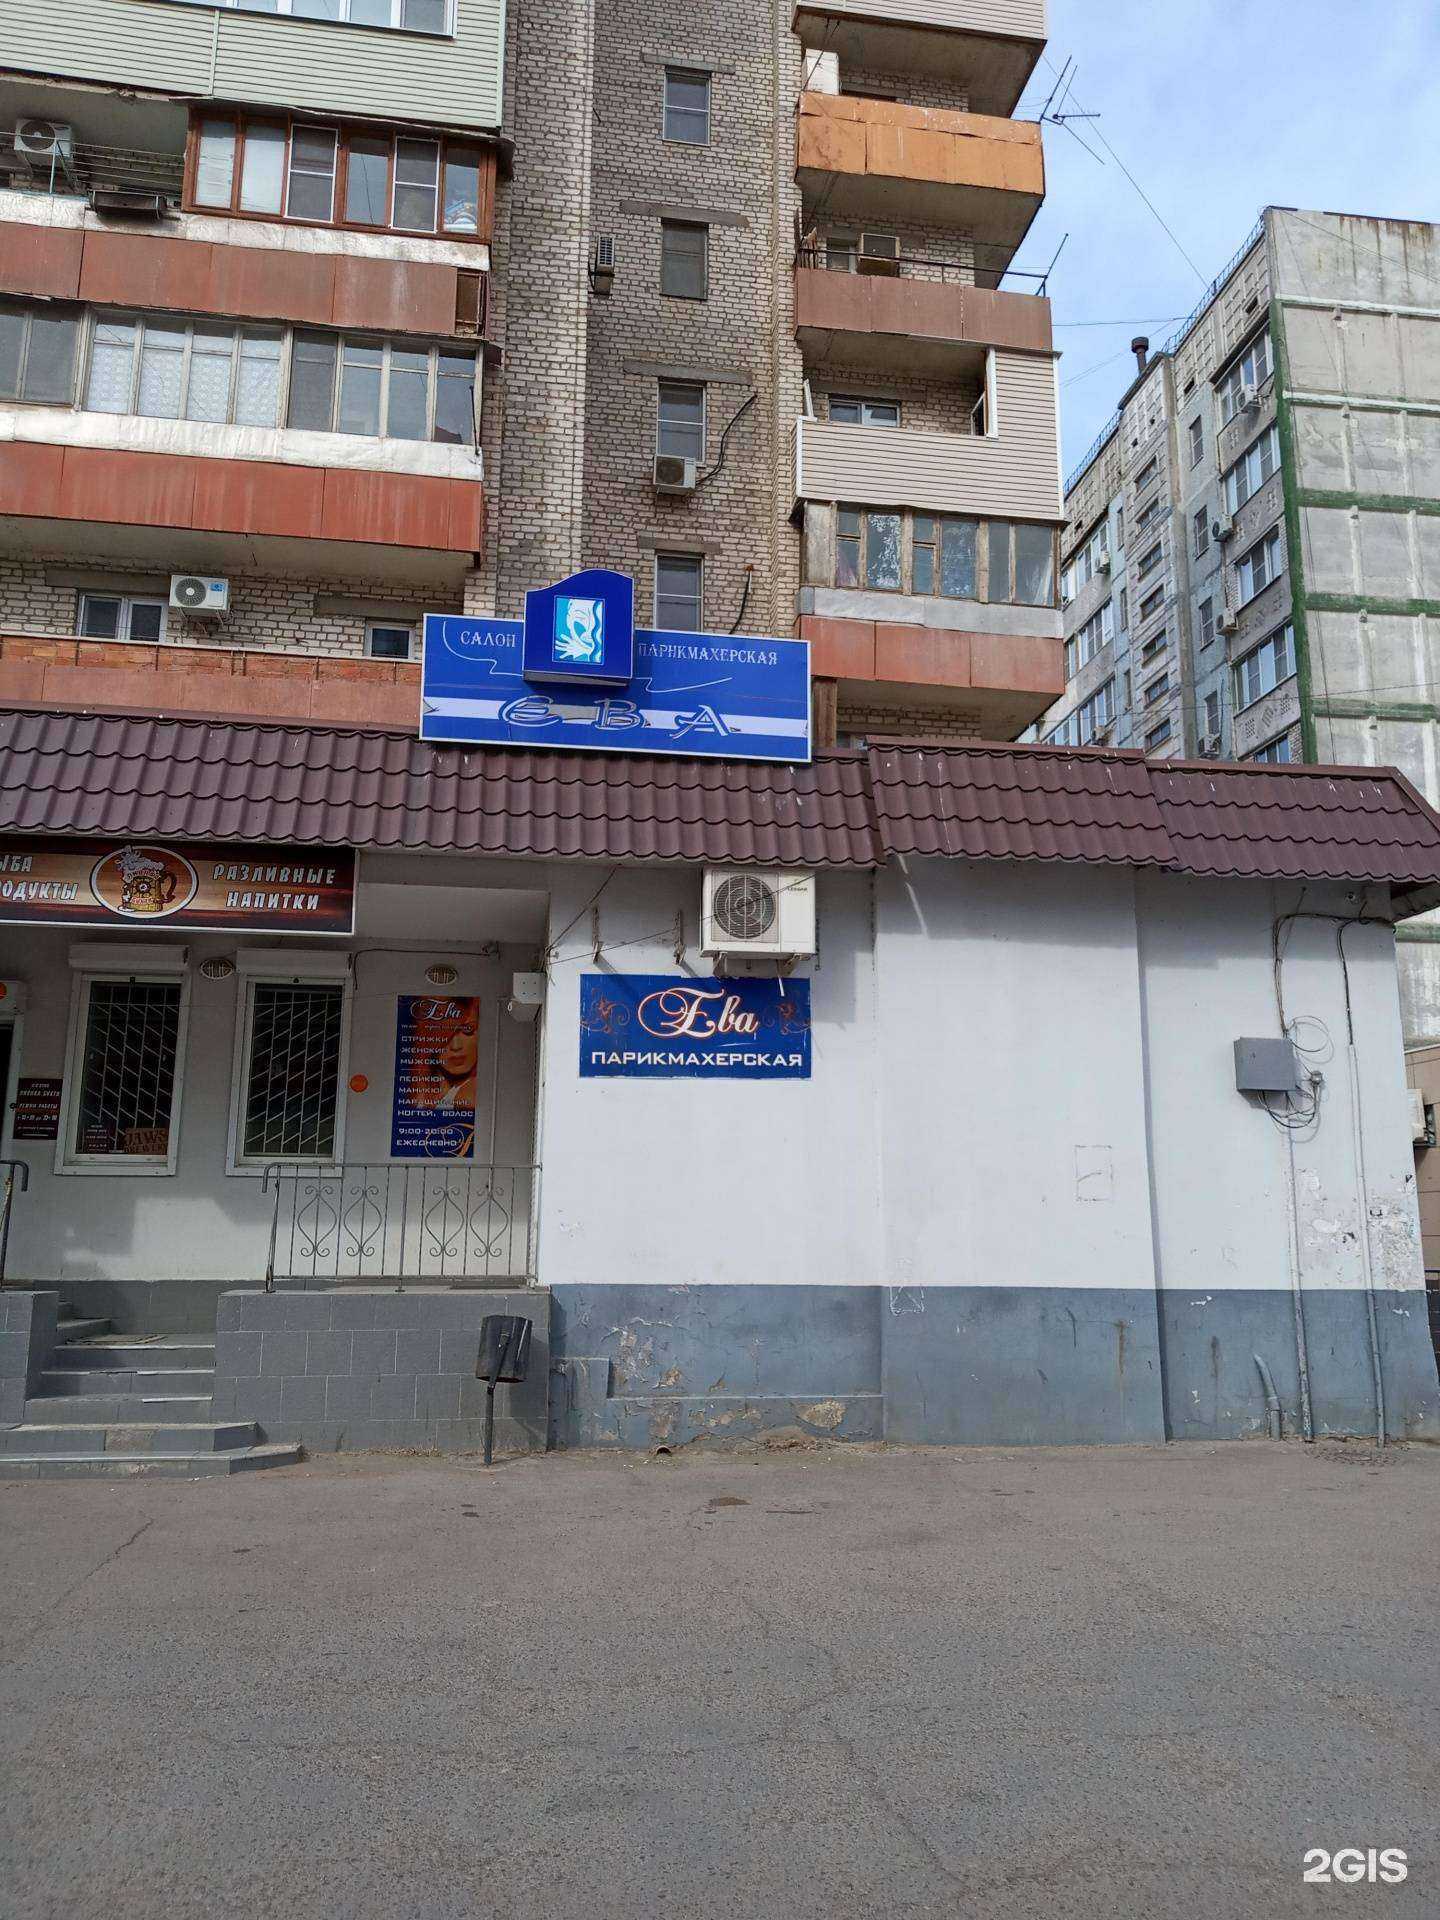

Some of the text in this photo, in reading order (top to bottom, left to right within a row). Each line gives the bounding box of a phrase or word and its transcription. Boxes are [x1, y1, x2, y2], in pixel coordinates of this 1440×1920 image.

[460, 630, 779, 666] САЛОН ПАРИКМАХЕРСКАЯ
[212, 864, 336, 885] РАЗЛИВНЫЕ
[0, 880, 78, 901] ОДУКТЫ
[226, 890, 320, 911] НАПИТКИ
[637, 987, 760, 1040] Ева
[401, 1035, 448, 1043] СТРИЖКИ
[400, 1046, 448, 1054] ЖЕНСКИЕ
[591, 1051, 803, 1067] ПАРИКМАХЕРСКАЯ
[399, 1075, 446, 1083] ПЕДИКЮР
[398, 1098, 470, 1106] НАРАЩИНИЕ
[397, 1109, 437, 1117] НОГТЕЙ,
[396, 1139, 457, 1147] ЕЖЕДНЕВНО
